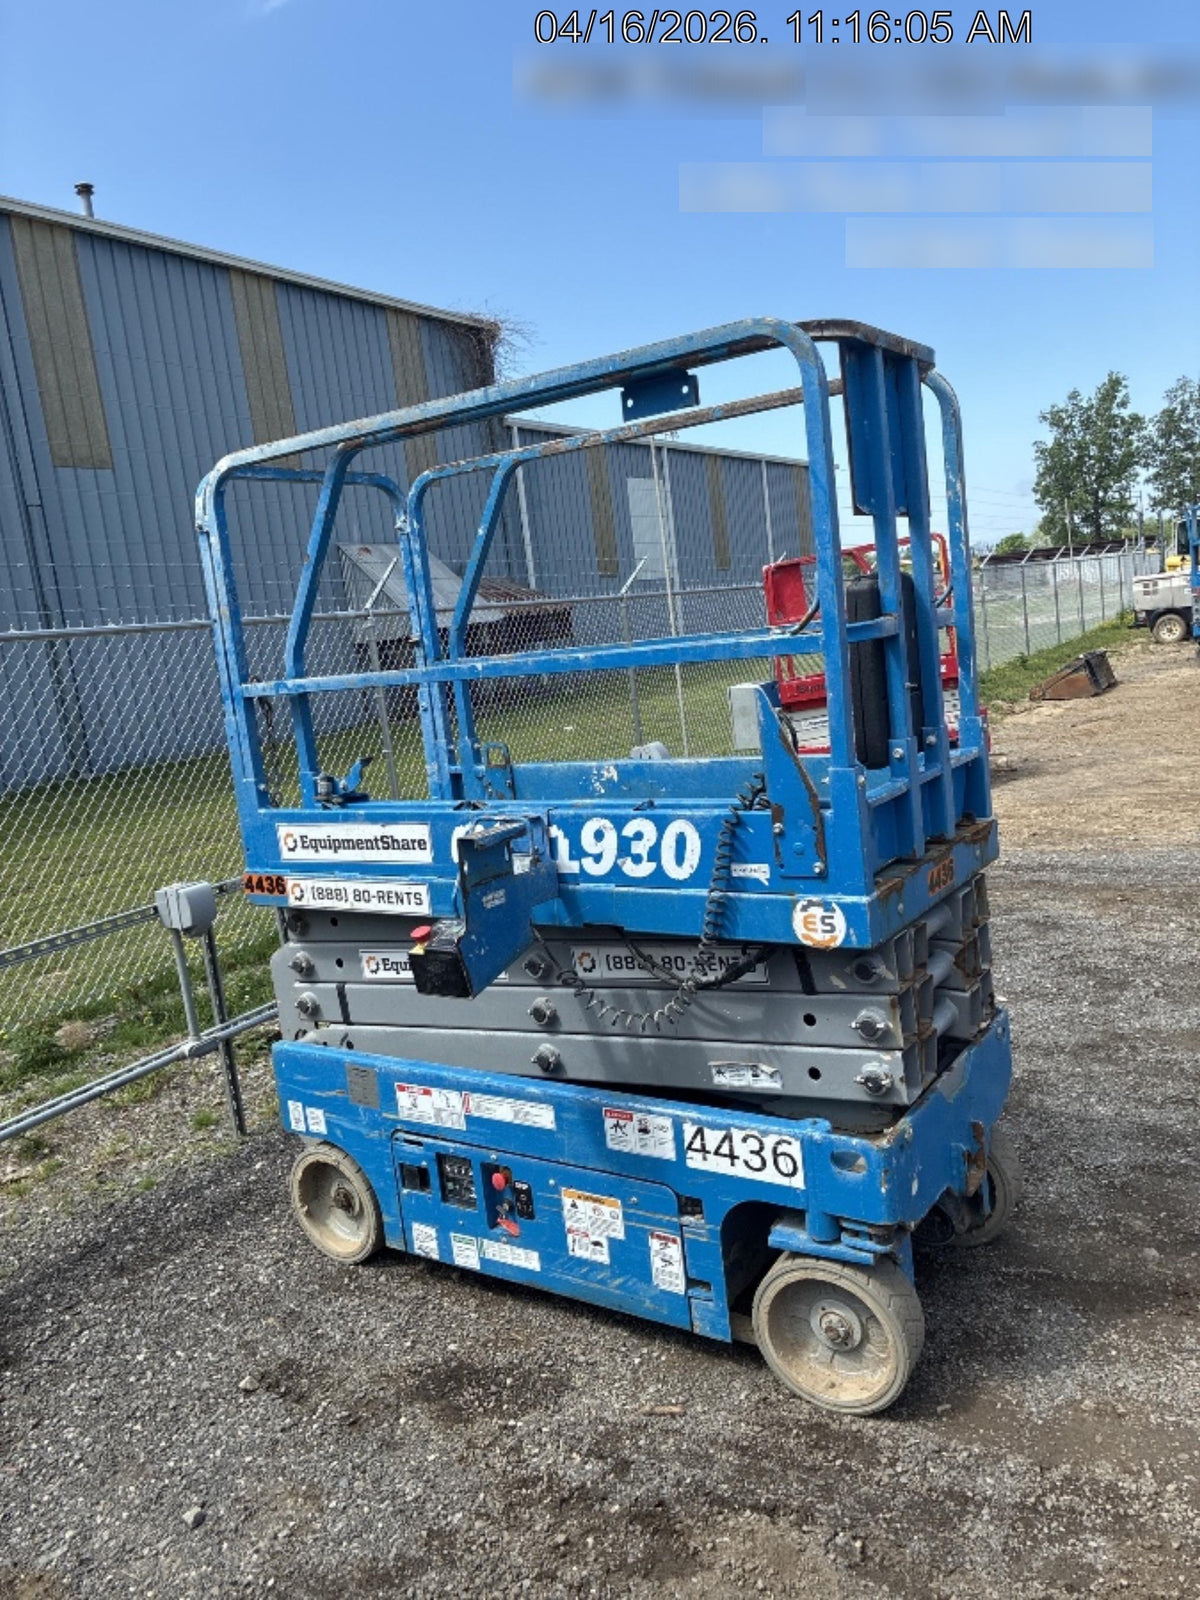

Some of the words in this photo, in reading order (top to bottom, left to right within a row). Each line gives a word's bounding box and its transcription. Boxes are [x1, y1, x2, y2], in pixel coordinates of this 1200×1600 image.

[299, 834, 427, 853] EquipmentShare
[245, 875, 287, 895] 4436
[311, 886, 350, 903] (888)
[353, 889, 423, 906] 80-RENTS
[802, 913, 836, 934] ES
[686, 1126, 799, 1178] 4436
